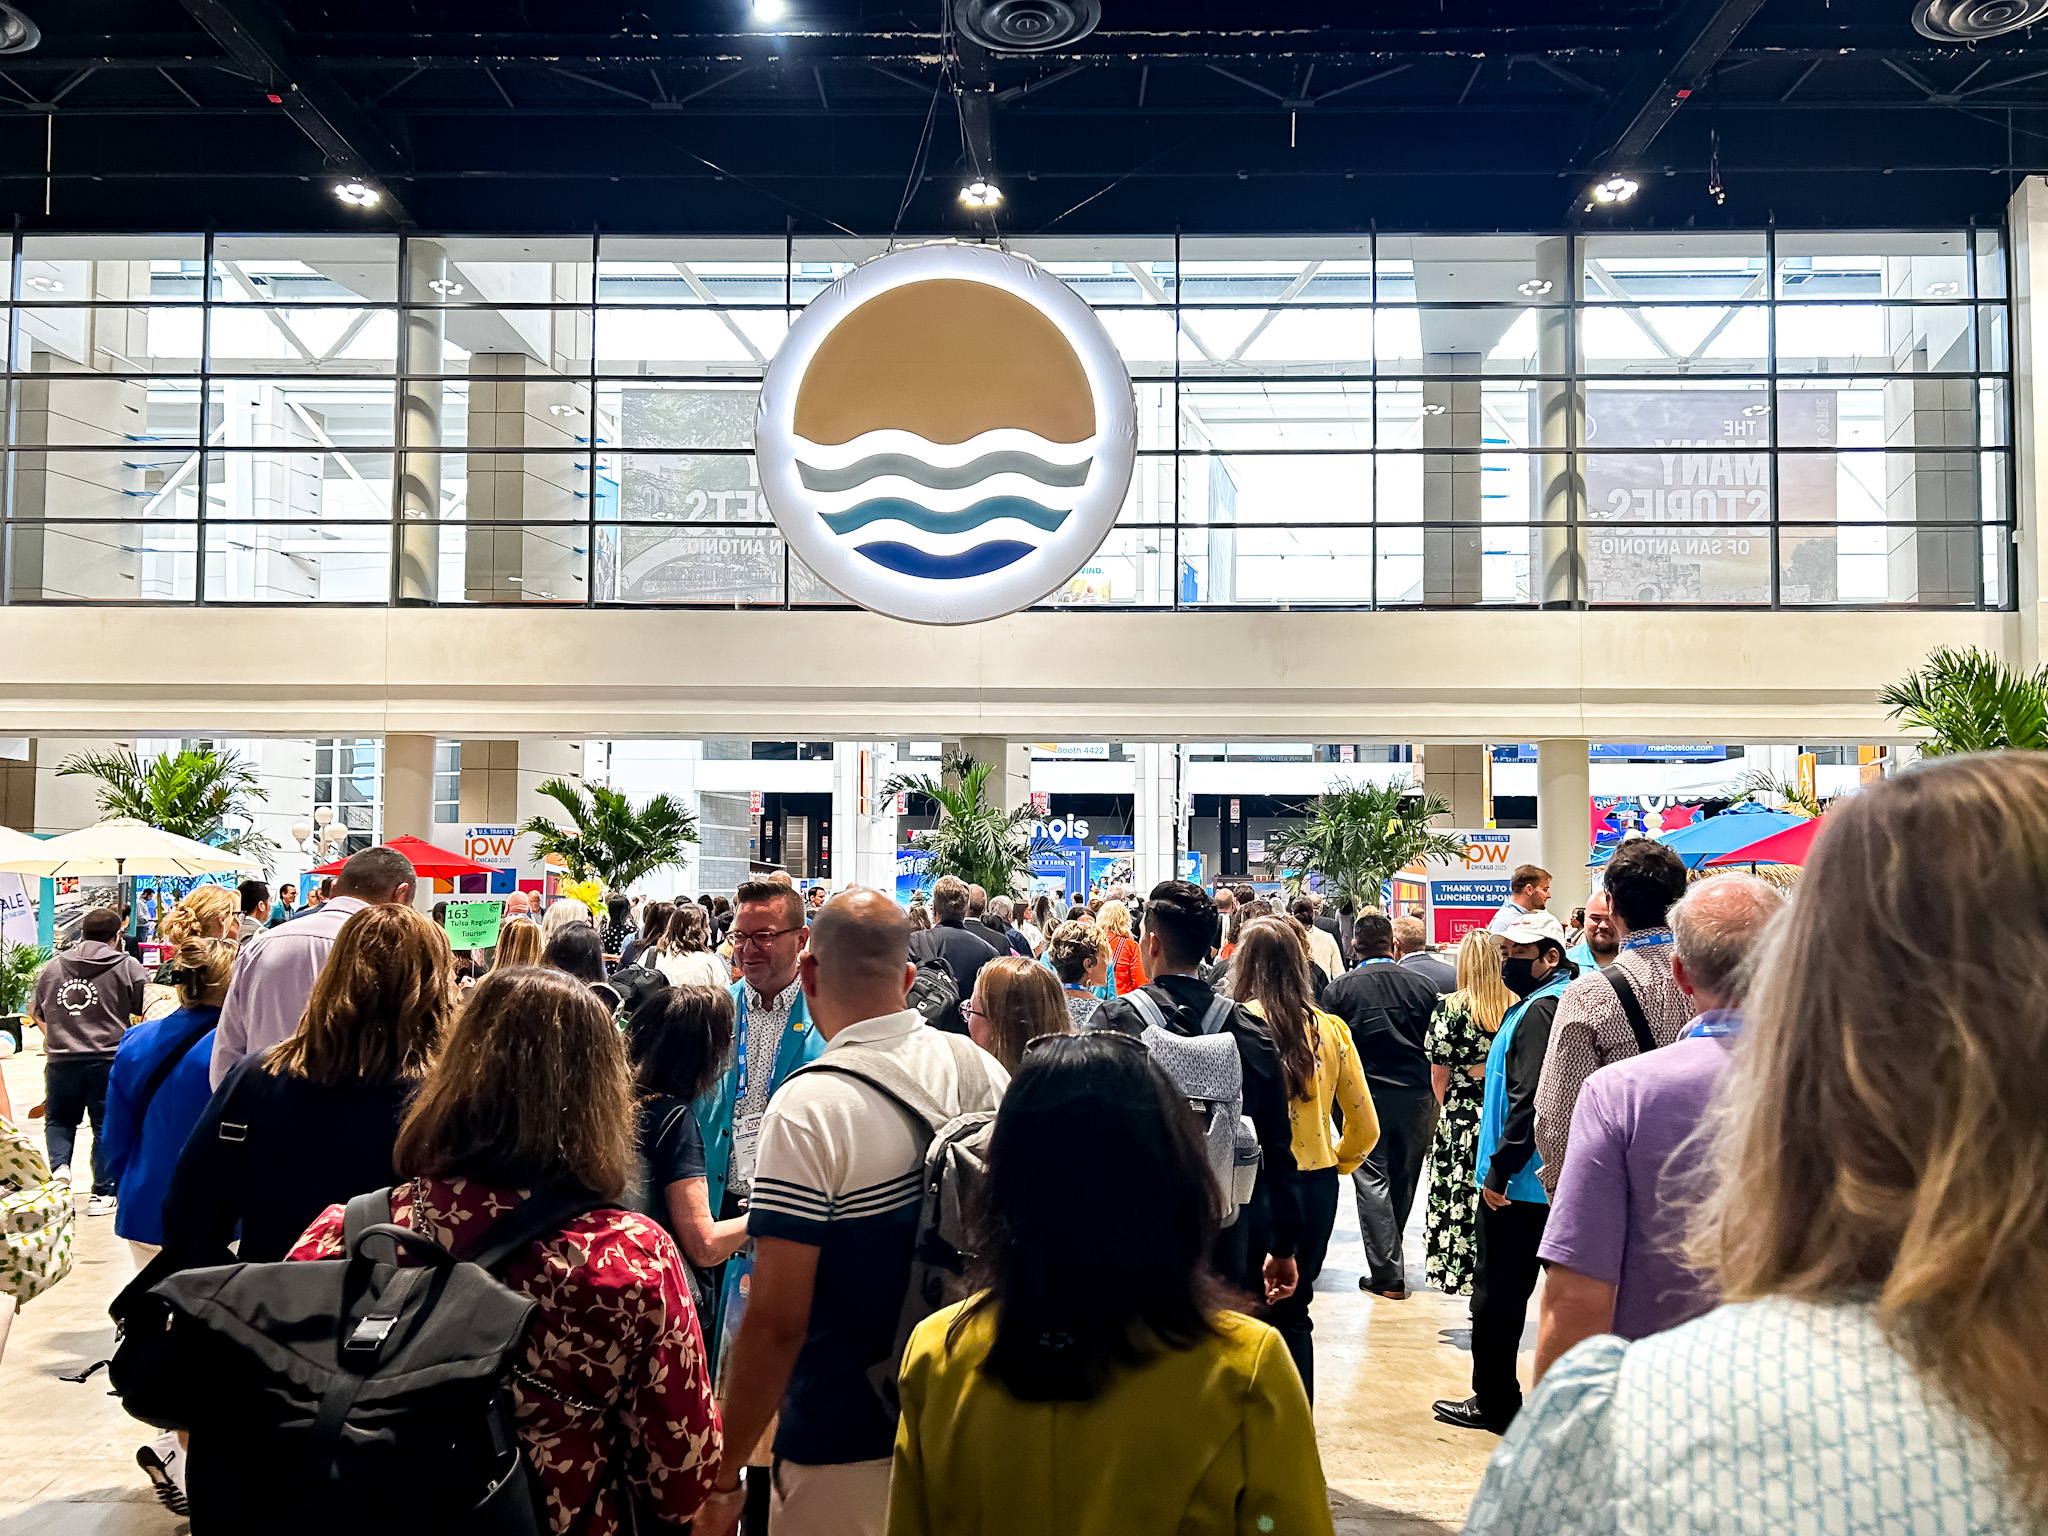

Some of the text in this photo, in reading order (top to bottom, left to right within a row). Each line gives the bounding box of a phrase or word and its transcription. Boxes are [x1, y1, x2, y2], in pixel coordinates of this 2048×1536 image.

[1057, 746, 1104, 754] Booth 4422
[1648, 744, 1714, 752] meetboston.com
[1441, 884, 1472, 893] THANK
[1474, 884, 1493, 893] YOU
[1435, 894, 1485, 902] LUNCHEON
[447, 909, 468, 919] 163
[471, 917, 497, 927] Regional
[1454, 924, 1476, 933] USA
